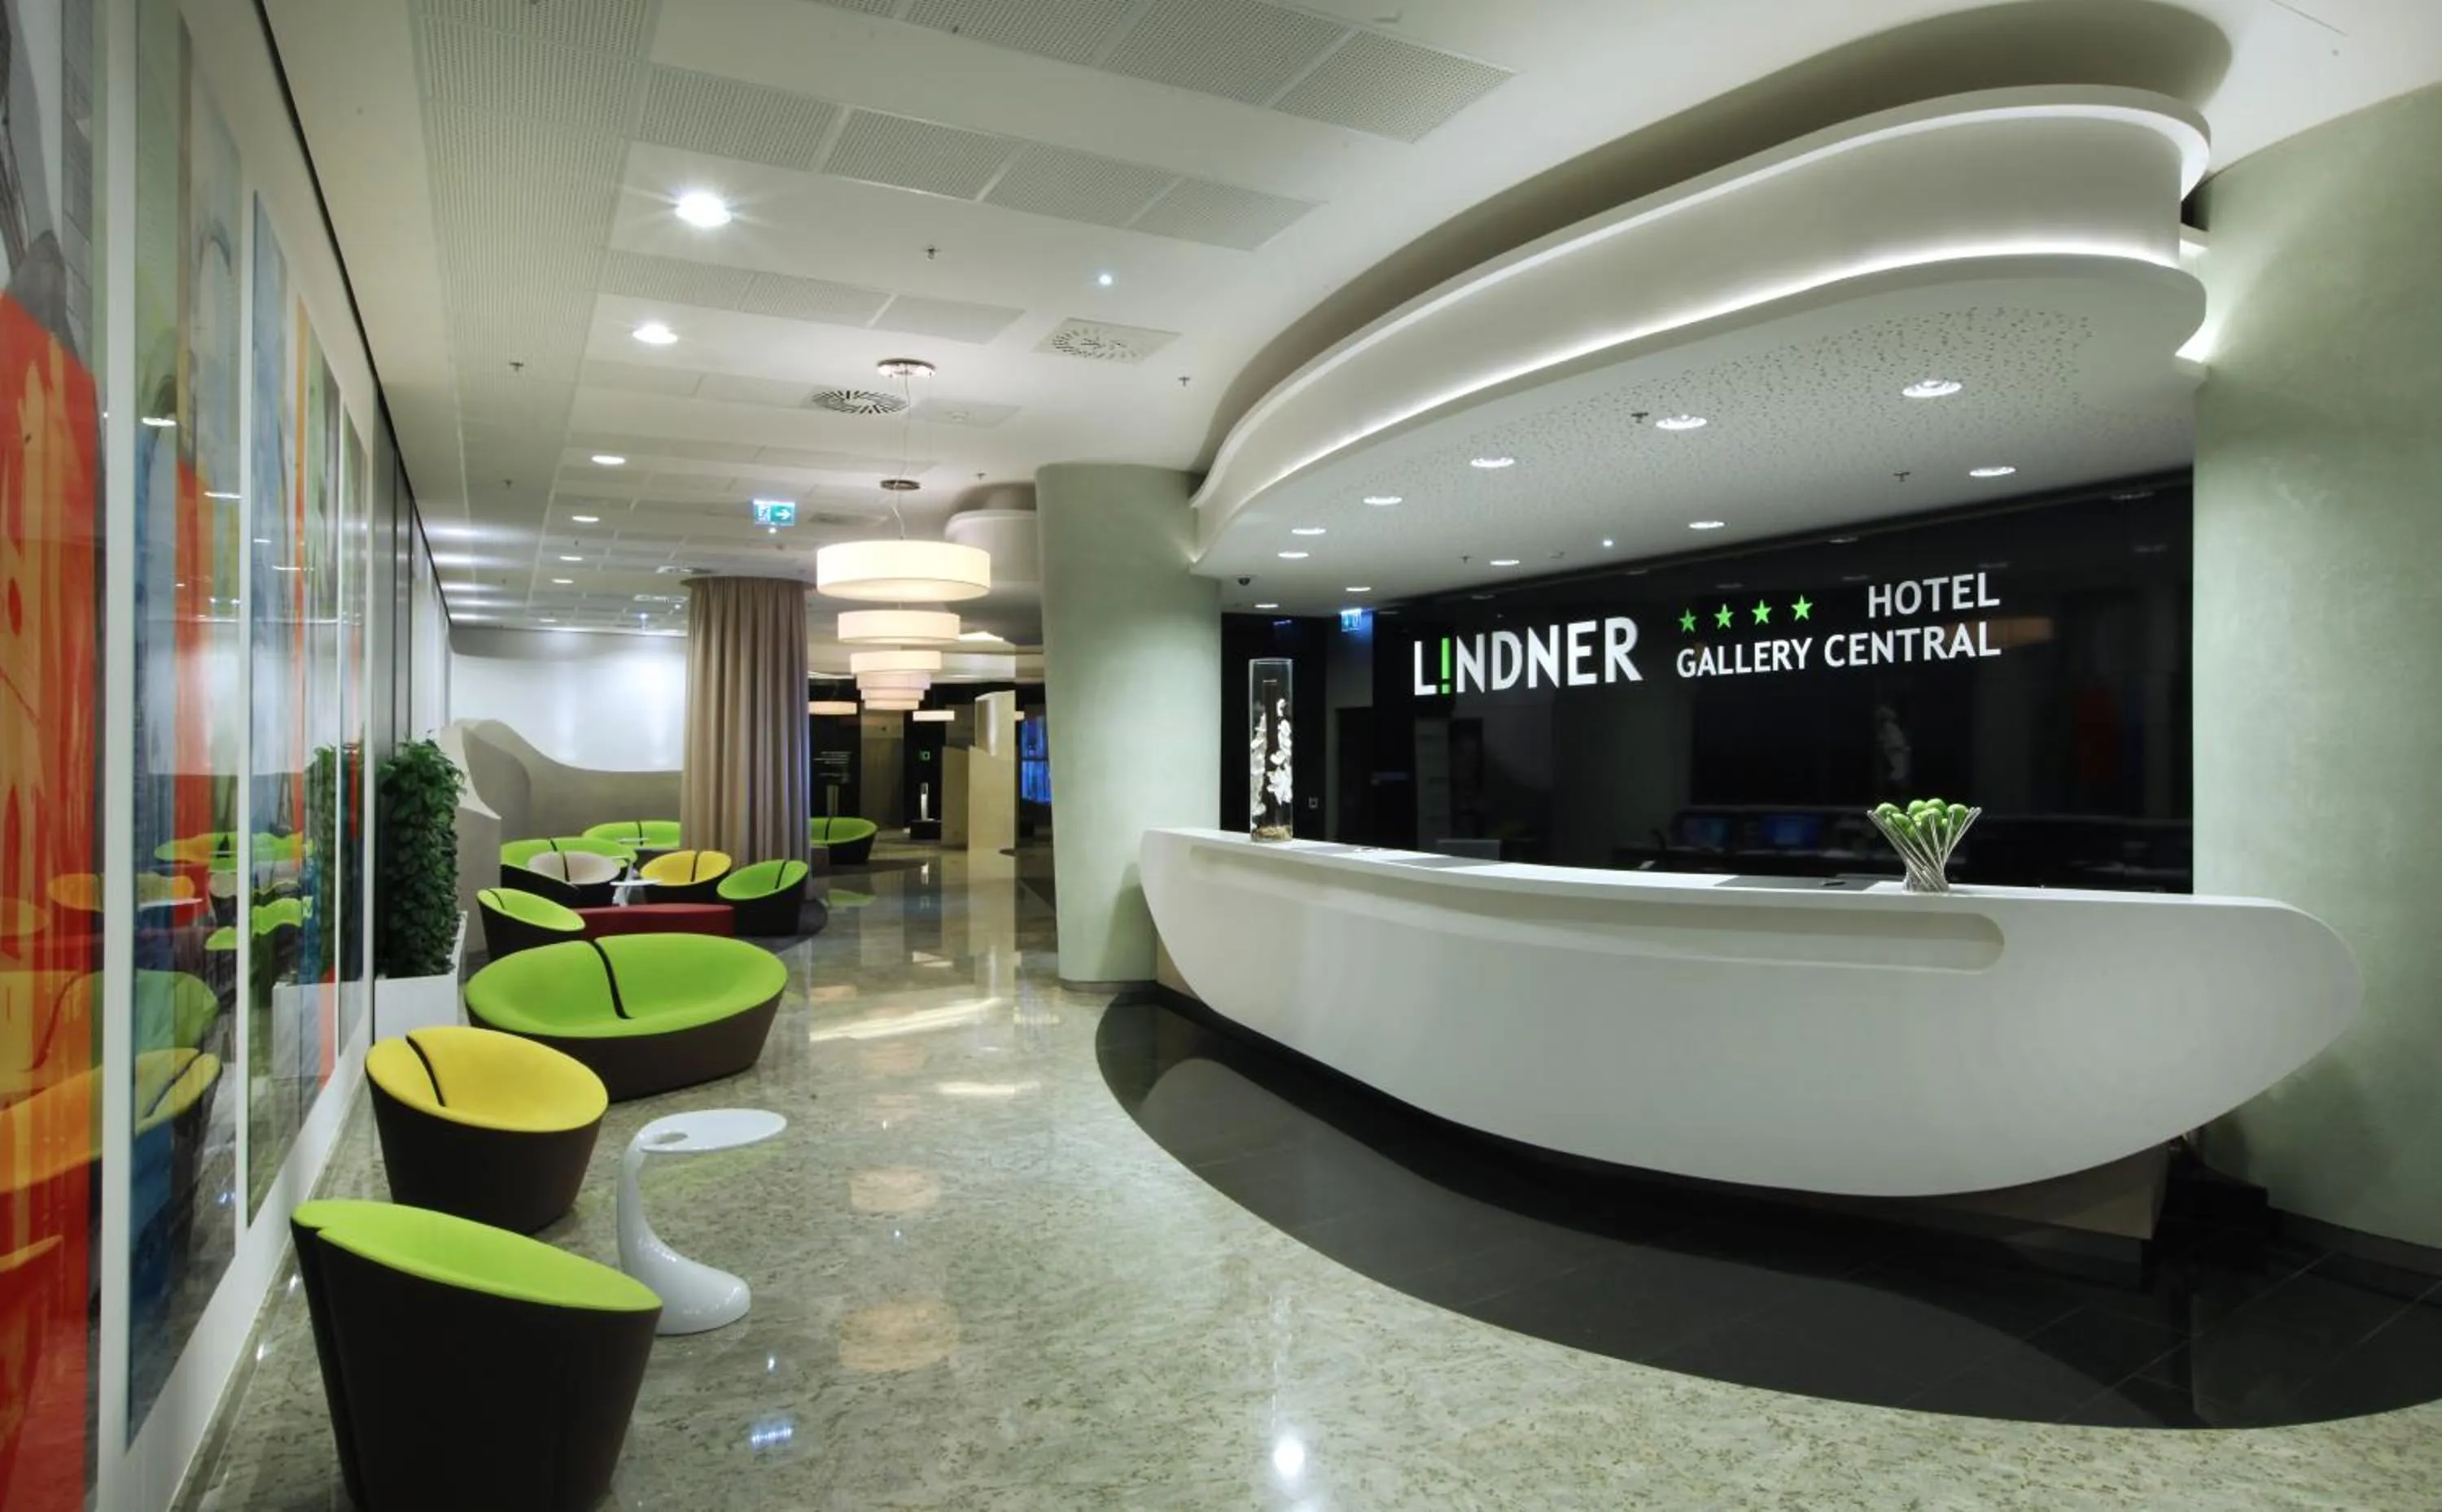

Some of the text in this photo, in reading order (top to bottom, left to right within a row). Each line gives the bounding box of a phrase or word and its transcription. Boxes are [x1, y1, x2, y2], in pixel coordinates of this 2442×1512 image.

[1867, 572, 2002, 618] HOTEL
[1675, 621, 2002, 678] GALLERY CENTRAL
